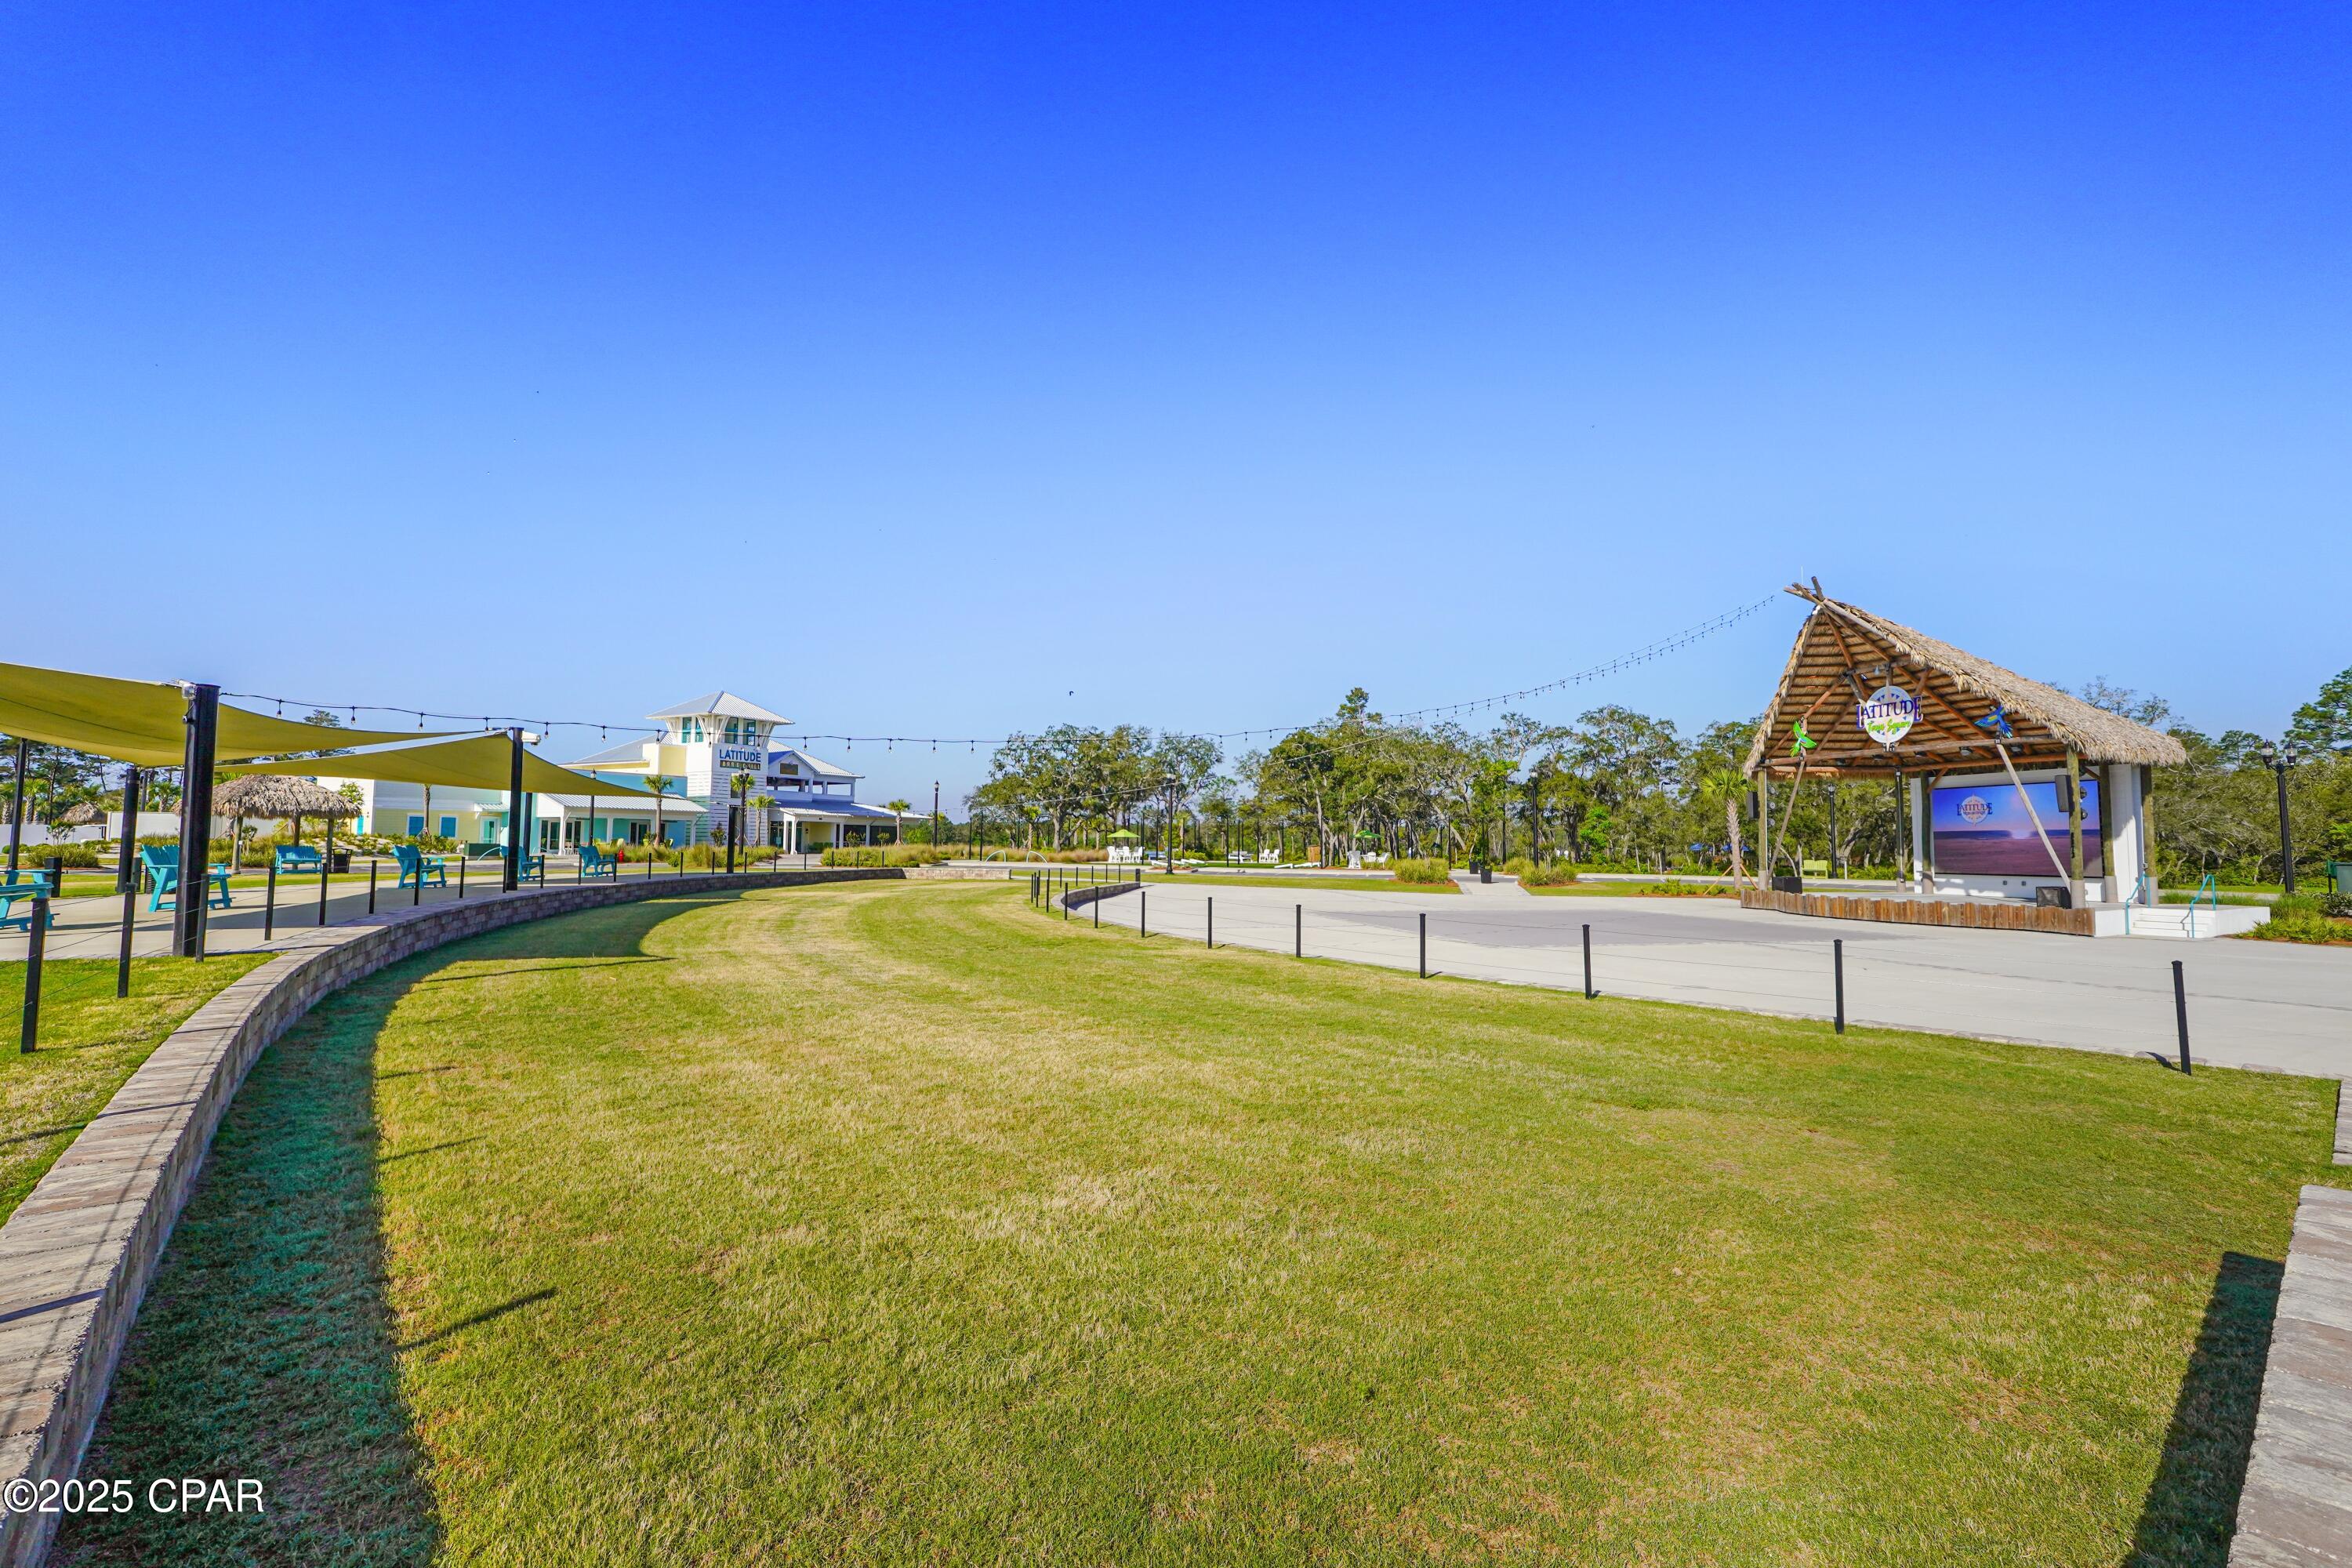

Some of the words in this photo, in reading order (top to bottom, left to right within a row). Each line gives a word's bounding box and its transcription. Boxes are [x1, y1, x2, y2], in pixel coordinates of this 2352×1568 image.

[1856, 695, 1923, 730] LATITUDE
[719, 749, 761, 763] LATITUDE
[1956, 802, 1993, 816] LATITUDE
